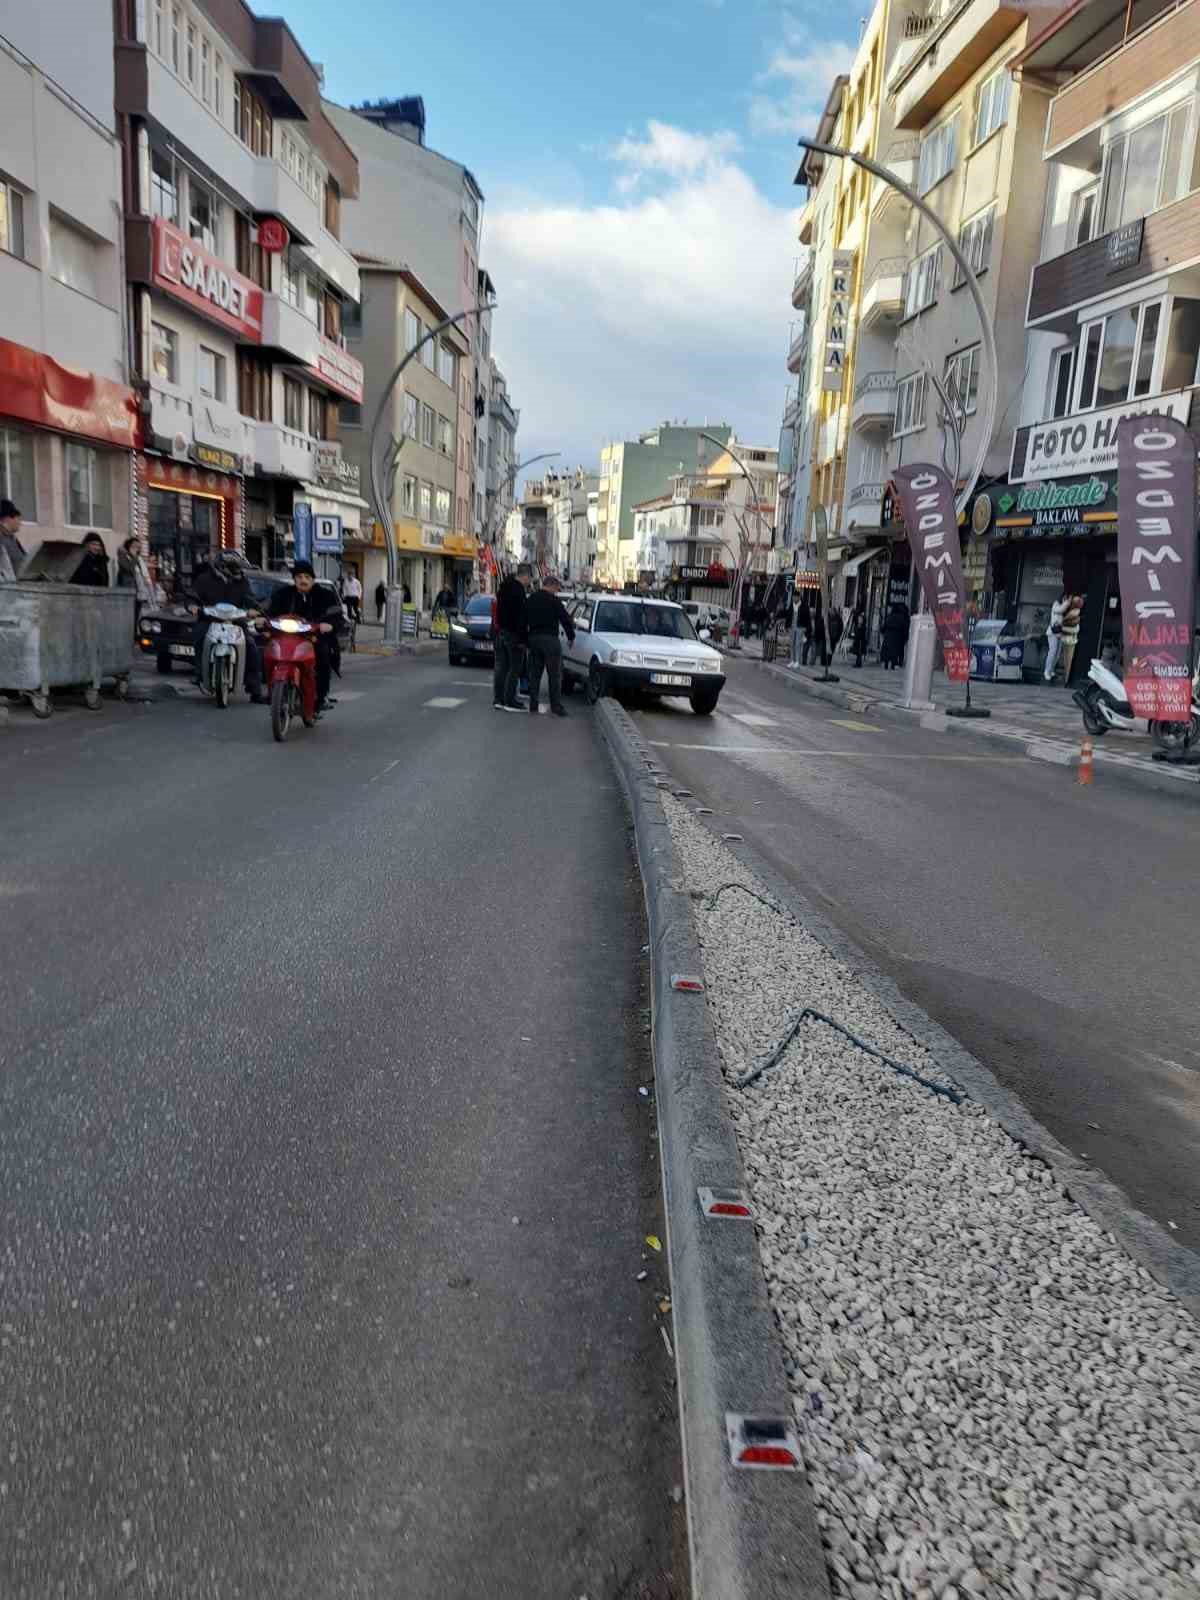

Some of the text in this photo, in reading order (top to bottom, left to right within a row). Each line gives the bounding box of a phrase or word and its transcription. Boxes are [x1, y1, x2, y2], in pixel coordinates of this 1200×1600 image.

[181, 246, 249, 320] SAADET
[1031, 424, 1087, 460] FOTO
[322, 520, 333, 537] D
[1036, 508, 1080, 525] BAKLAVA
